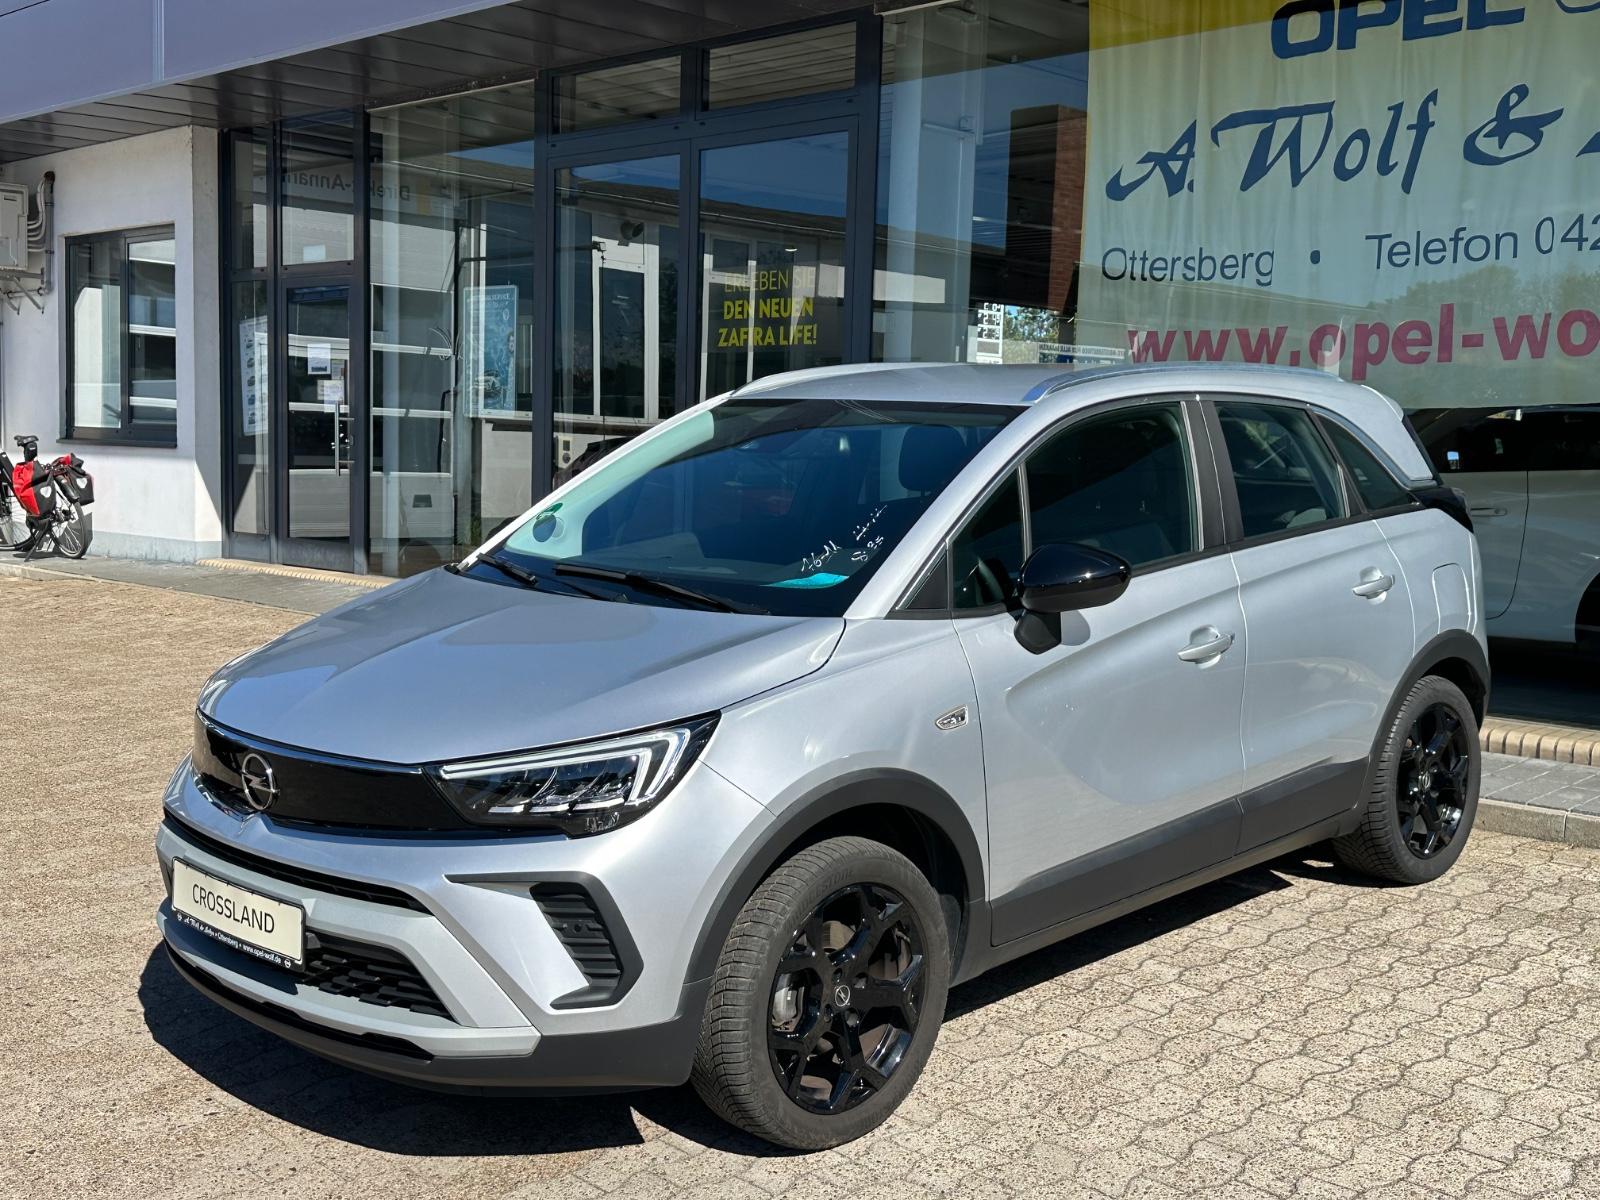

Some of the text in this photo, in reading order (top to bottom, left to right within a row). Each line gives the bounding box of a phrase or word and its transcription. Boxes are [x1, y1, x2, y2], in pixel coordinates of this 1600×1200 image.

[1271, 0, 1525, 59] OPEL
[1463, 83, 1565, 166] &
[724, 270, 789, 293] ERLEBEN
[1100, 247, 1275, 287] Ottersberg
[1365, 227, 1519, 270] Telefon
[723, 297, 814, 320] DEN NEUEN
[779, 324, 817, 345] LIFE!
[192, 883, 275, 934] CROSSLAND
